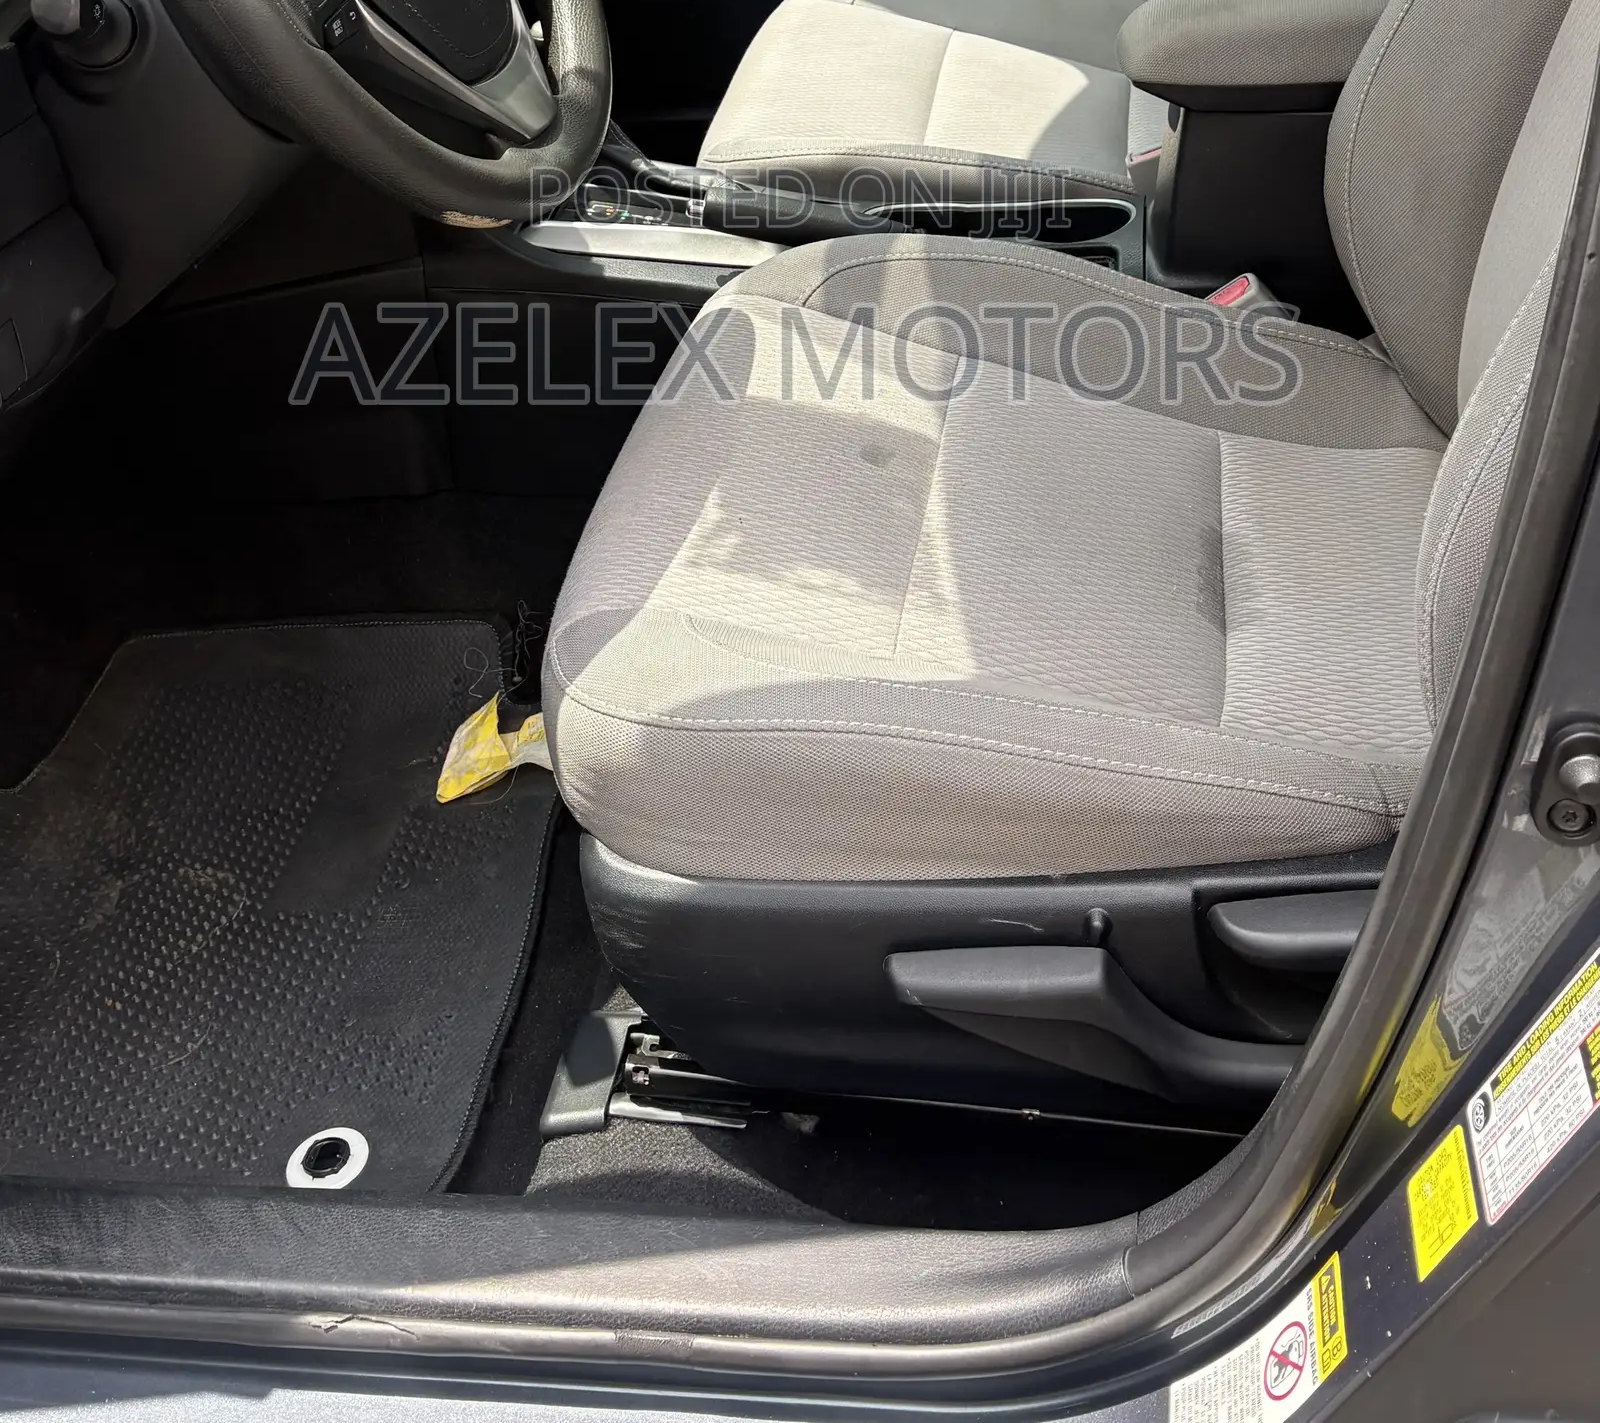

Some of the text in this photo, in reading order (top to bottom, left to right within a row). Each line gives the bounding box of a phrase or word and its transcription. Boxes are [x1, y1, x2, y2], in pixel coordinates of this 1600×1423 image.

[1498, 1060, 1513, 1083] TIRE
[1512, 1043, 1526, 1066] AND
[1526, 1010, 1554, 1050] LOADING
[1553, 958, 1597, 1016] INFORMATION
[1563, 1002, 1570, 1016] ET
[1570, 995, 1576, 1008] LE
[1321, 1292, 1330, 1342] ATTENTION
[1327, 1284, 1336, 1326] CAUTION
[1309, 1339, 1318, 1386] AIRBAG
